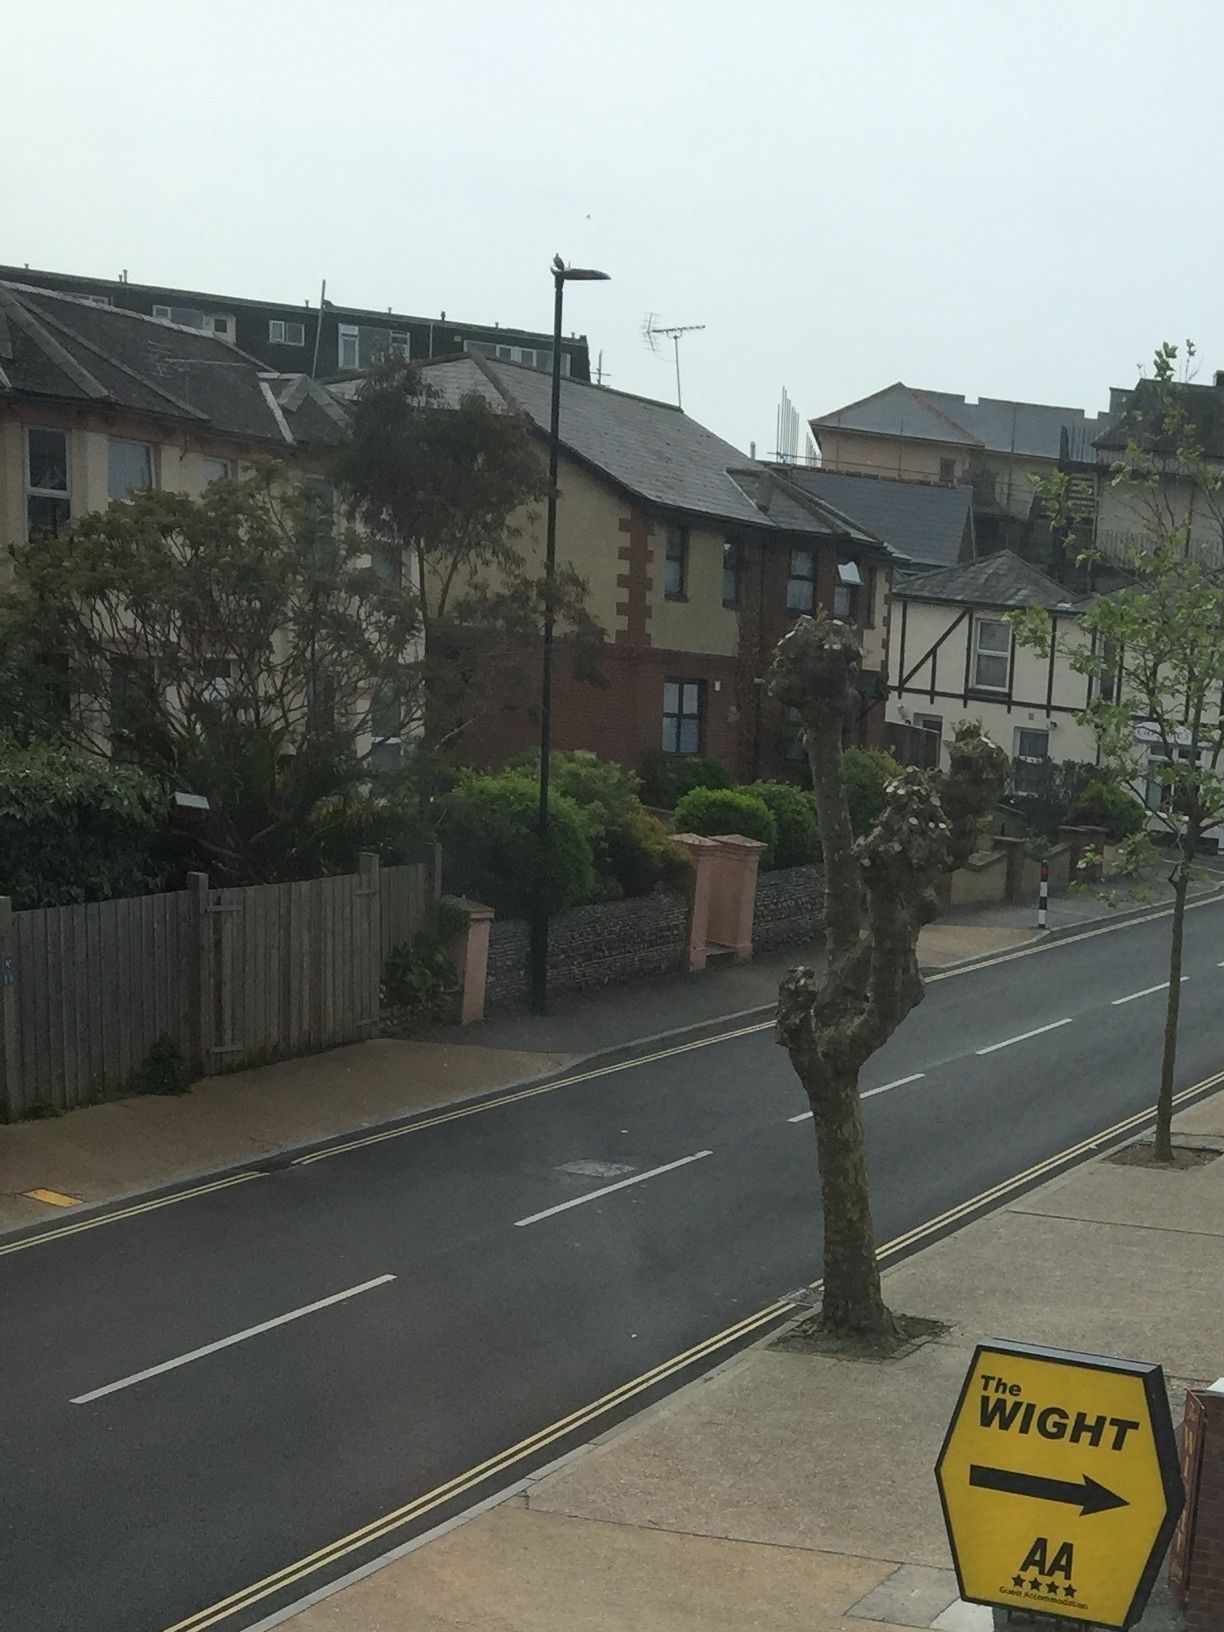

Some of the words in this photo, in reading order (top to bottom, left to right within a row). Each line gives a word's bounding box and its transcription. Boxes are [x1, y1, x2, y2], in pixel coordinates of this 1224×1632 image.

[980, 1374, 1022, 1397] The
[979, 1395, 1141, 1452] WIGHT
[1020, 1537, 1074, 1581] AA
